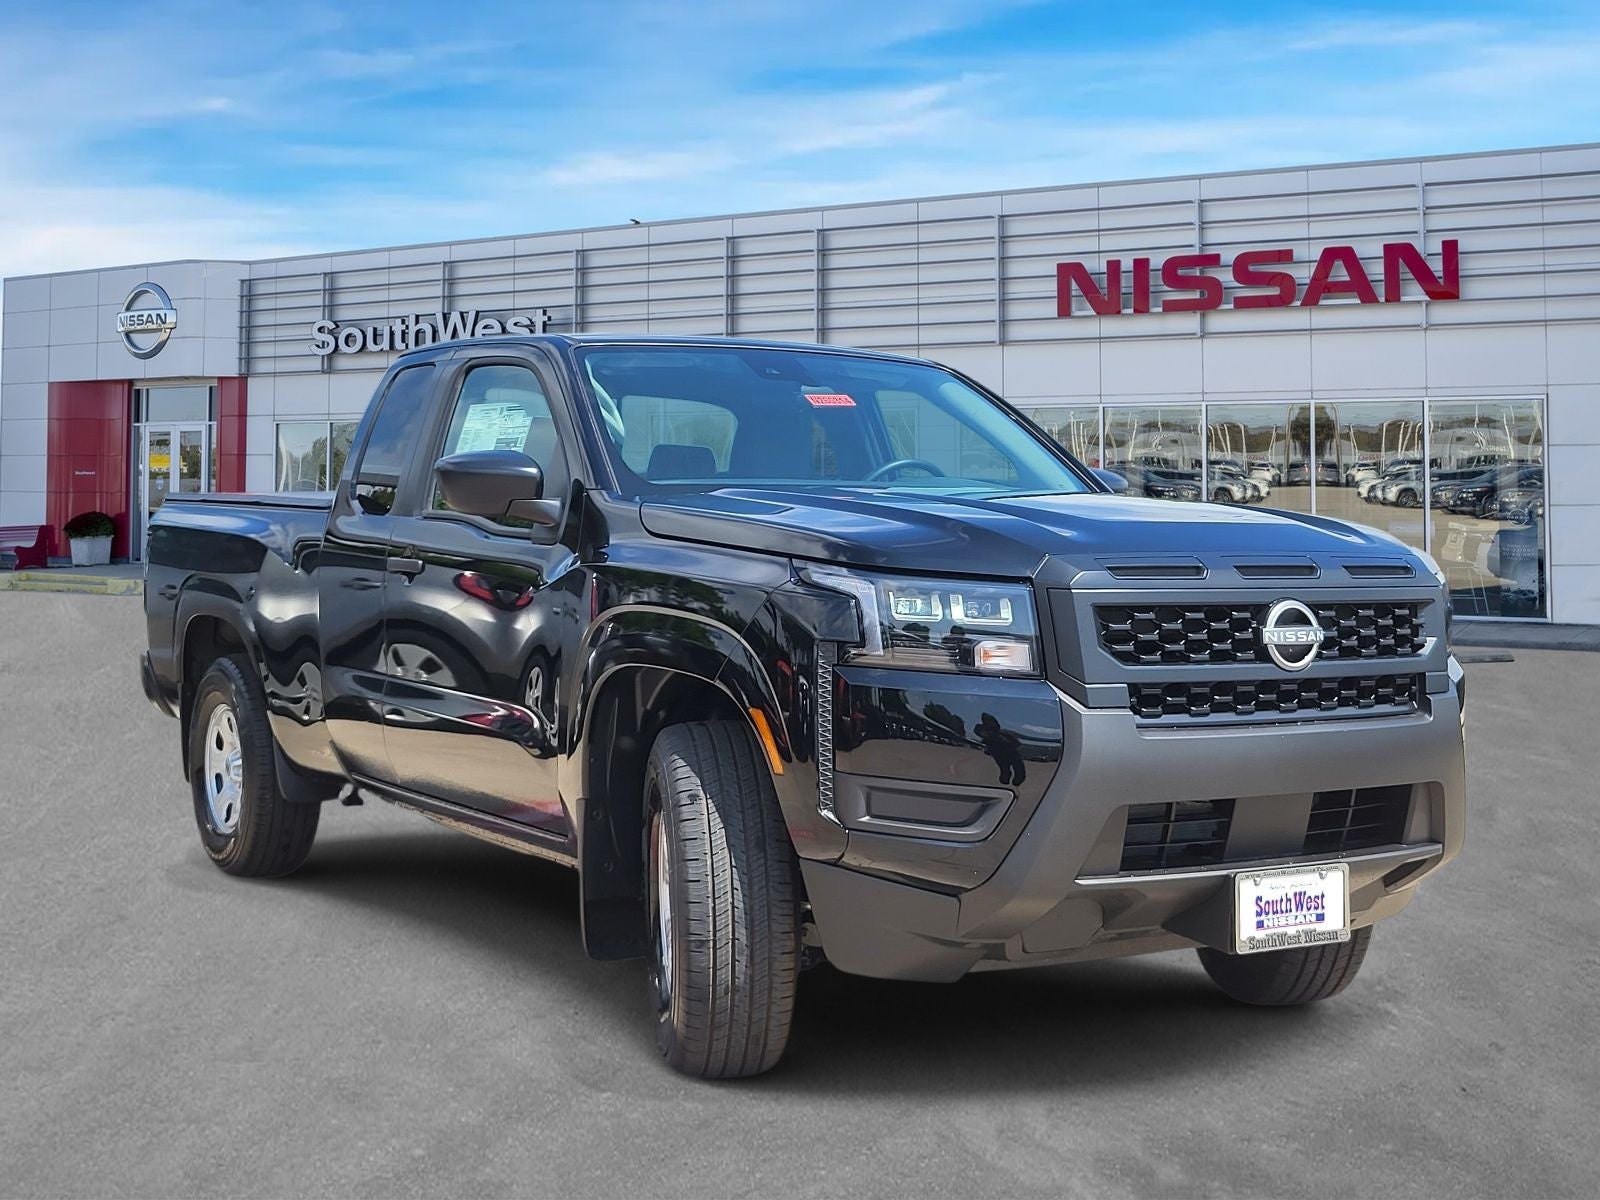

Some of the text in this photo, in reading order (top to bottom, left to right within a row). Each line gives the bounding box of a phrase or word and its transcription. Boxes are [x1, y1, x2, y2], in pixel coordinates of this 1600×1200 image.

[1057, 239, 1460, 317] NISSAN
[119, 312, 167, 328] NISSAN
[309, 309, 551, 355] SouthWest
[1264, 630, 1324, 643] NISSAN
[1255, 890, 1325, 917] SouthWest
[1264, 913, 1317, 928] NISSAN
[1248, 929, 1339, 950] SouthWest Nissan
